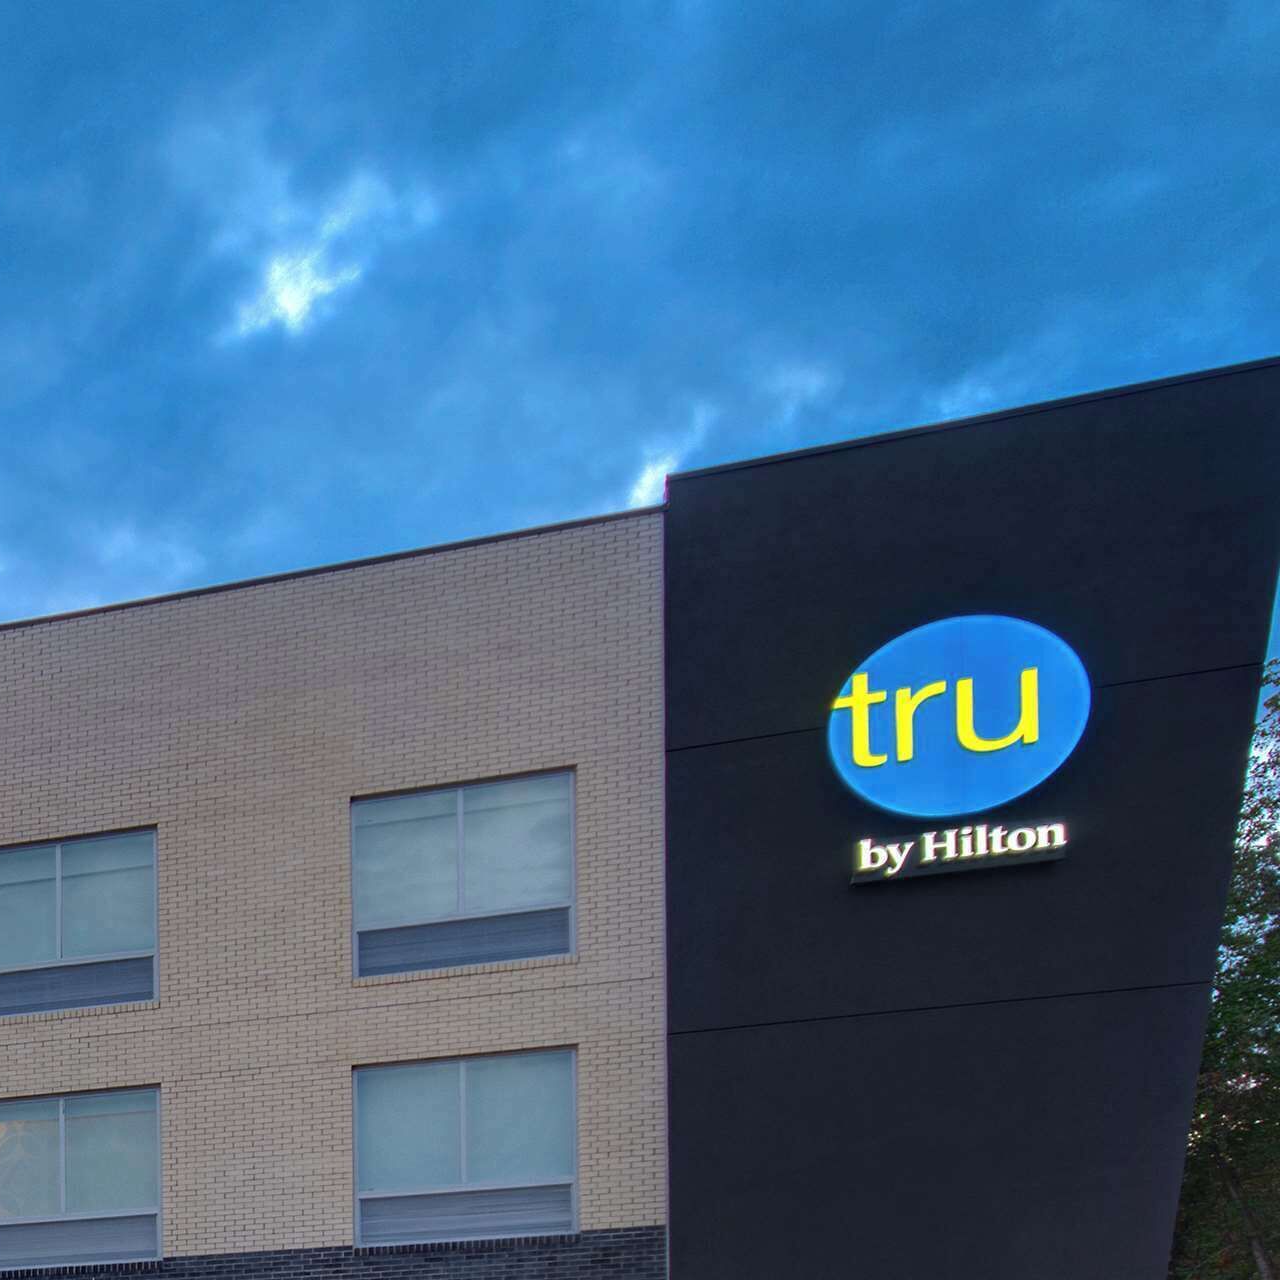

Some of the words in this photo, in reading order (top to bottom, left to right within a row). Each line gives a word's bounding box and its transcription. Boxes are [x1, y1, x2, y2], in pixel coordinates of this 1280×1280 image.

[831, 666, 1039, 767] tru
[857, 837, 914, 877] by
[920, 820, 1068, 862] Hilton
